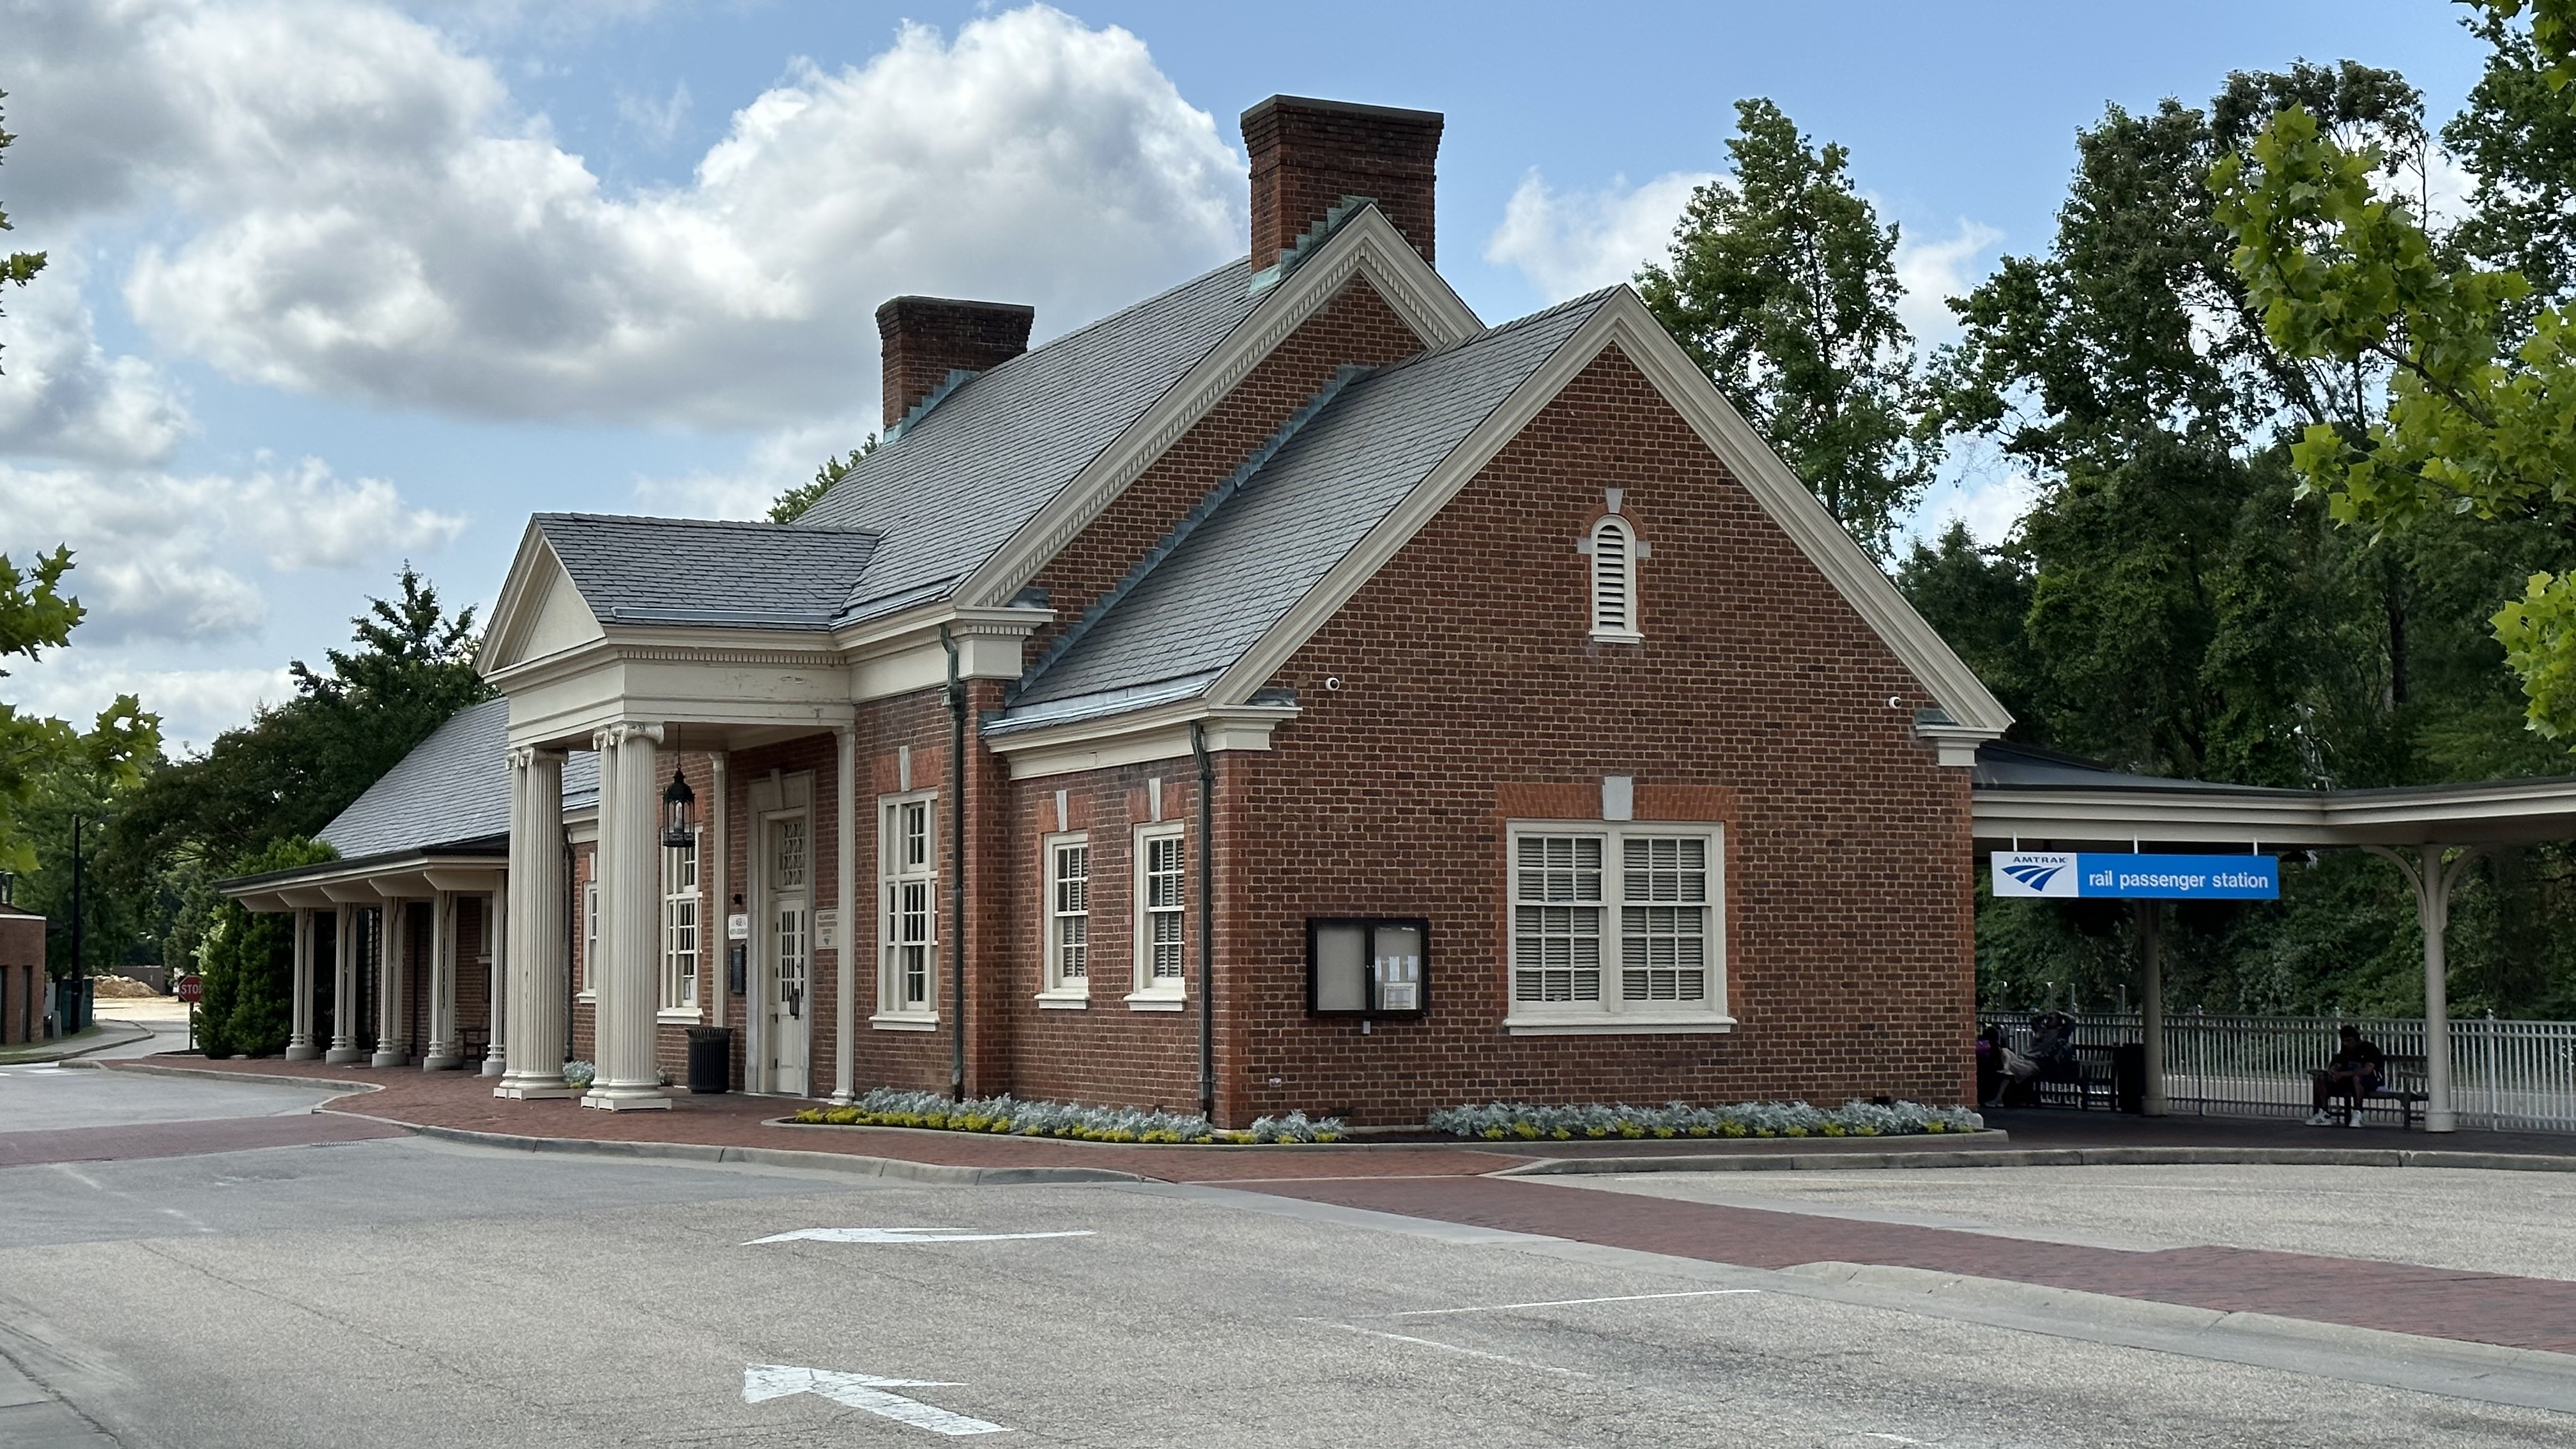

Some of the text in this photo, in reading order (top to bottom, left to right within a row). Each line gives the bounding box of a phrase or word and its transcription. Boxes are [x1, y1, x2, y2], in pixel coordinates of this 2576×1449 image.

[2089, 870, 2269, 891] rail passenger station
